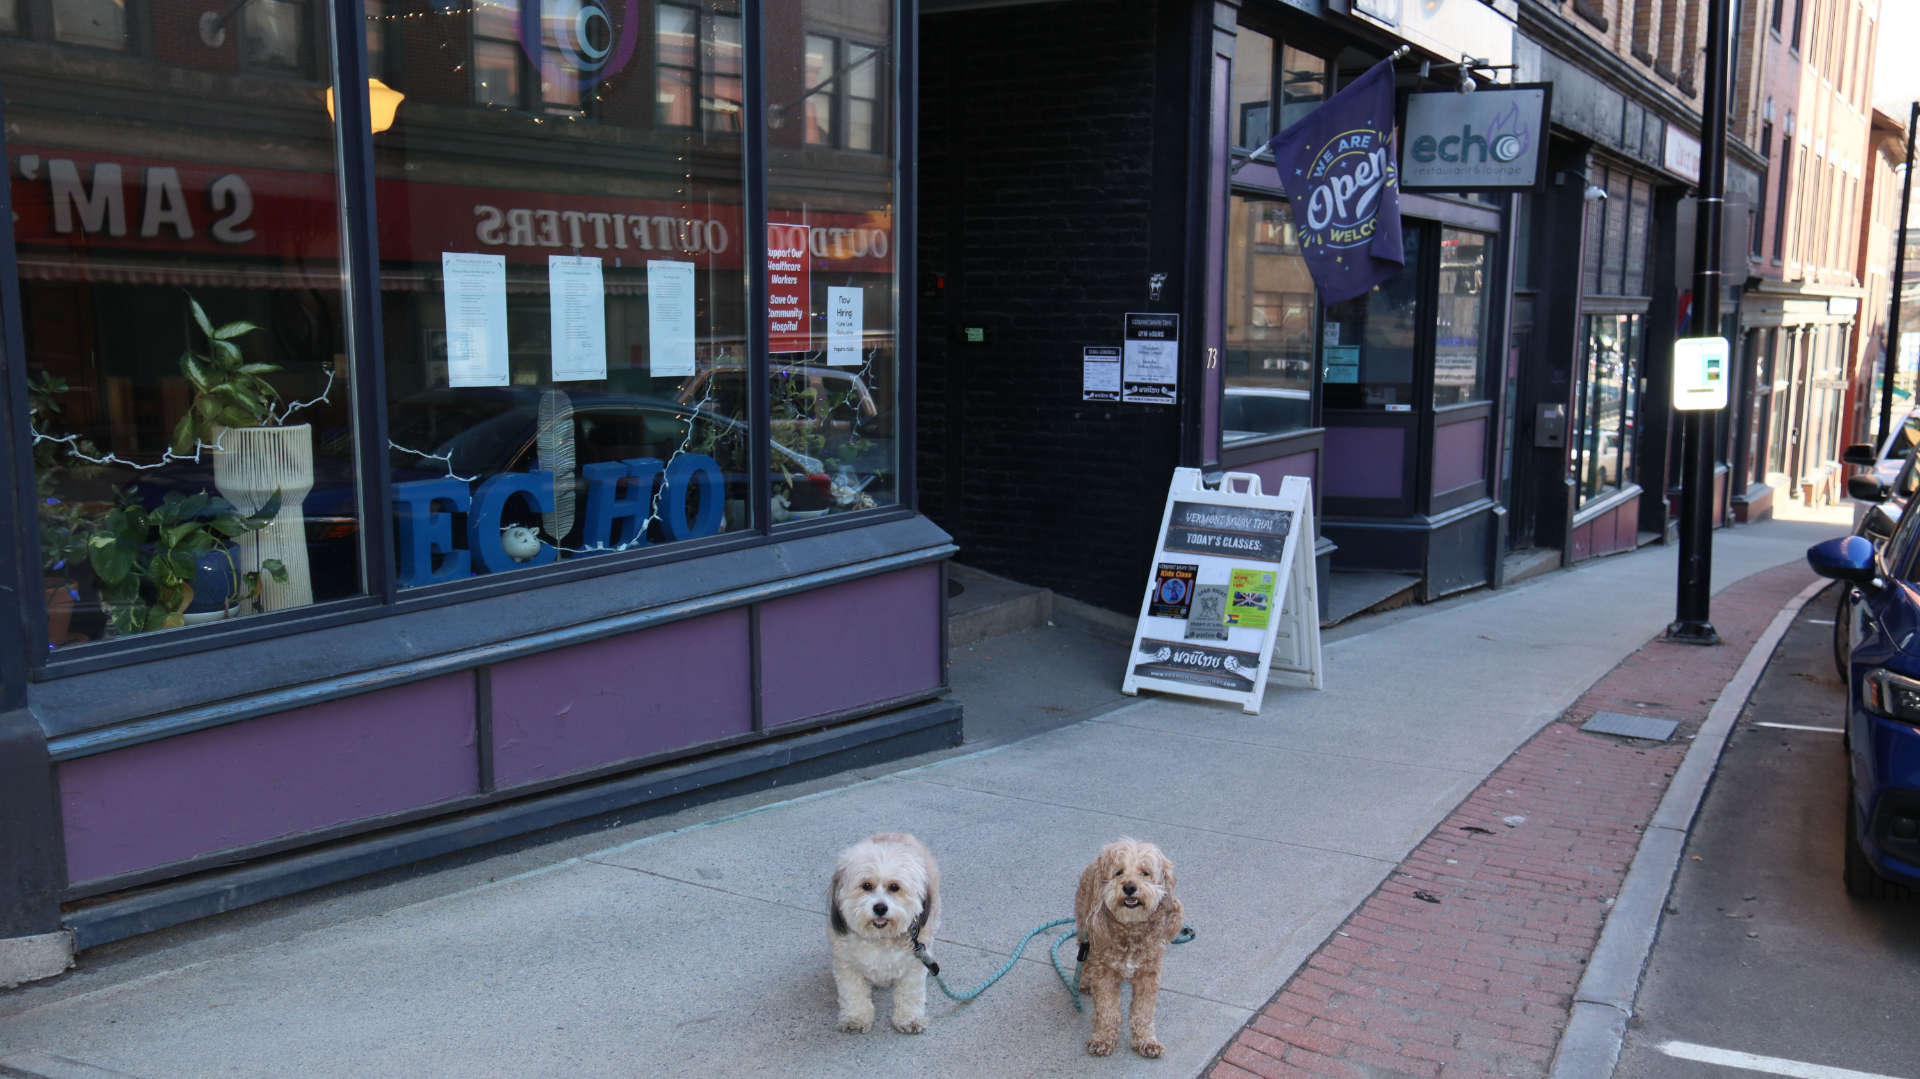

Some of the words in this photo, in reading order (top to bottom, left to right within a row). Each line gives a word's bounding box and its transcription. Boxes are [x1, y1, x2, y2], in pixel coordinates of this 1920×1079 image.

[1412, 124, 1520, 163] echo
[1313, 152, 1334, 177] WE
[1338, 135, 1372, 152] ARE
[1307, 147, 1387, 230] Open
[791, 248, 803, 258] Our
[771, 273, 798, 285] Workers
[770, 294, 786, 304] Save
[787, 294, 799, 304] Our
[771, 321, 799, 334] Hospital
[1207, 347, 1218, 369] 73
[391, 453, 726, 588] ECHO
[1185, 512, 1225, 526] VERMONT
[1187, 533, 1221, 547] TODAY'S
[1222, 537, 1263, 551] CLASSES:
